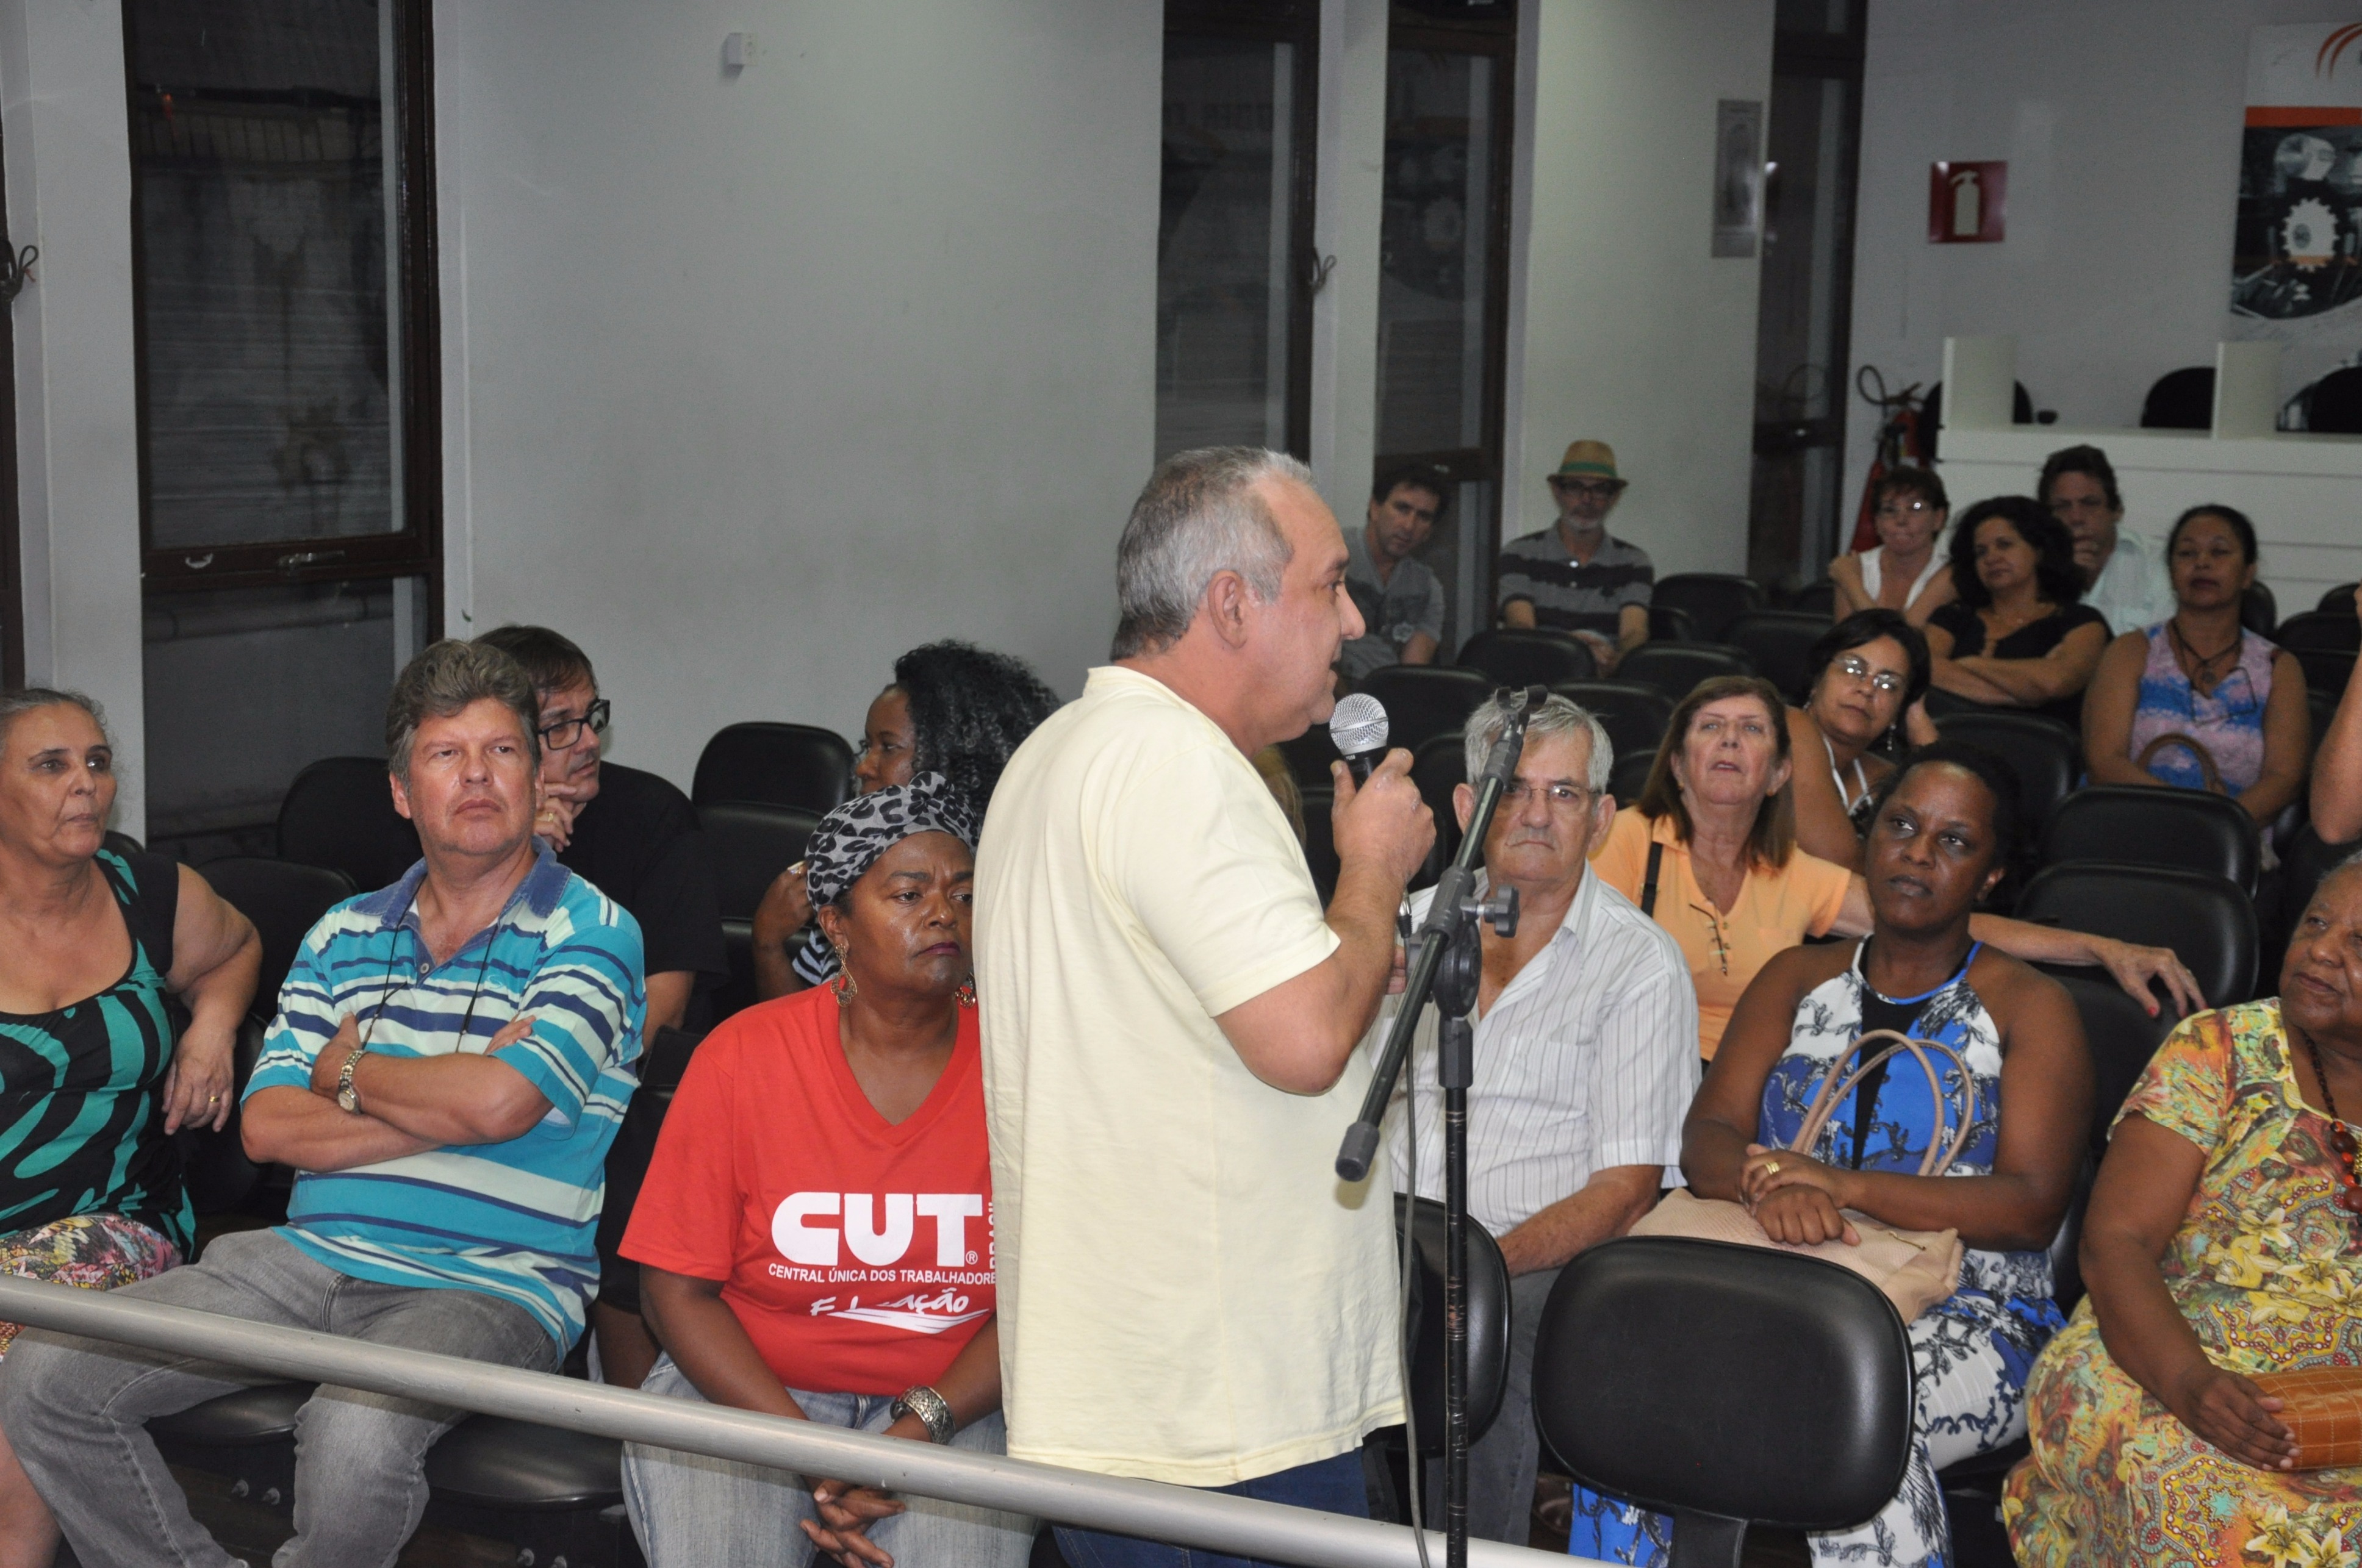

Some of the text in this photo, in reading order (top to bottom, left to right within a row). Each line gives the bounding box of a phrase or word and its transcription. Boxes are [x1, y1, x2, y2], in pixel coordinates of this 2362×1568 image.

[771, 1192, 983, 1267] CUT
[769, 1263, 996, 1284] CENTRAL ÚNICA DOS TRABALHADORE
